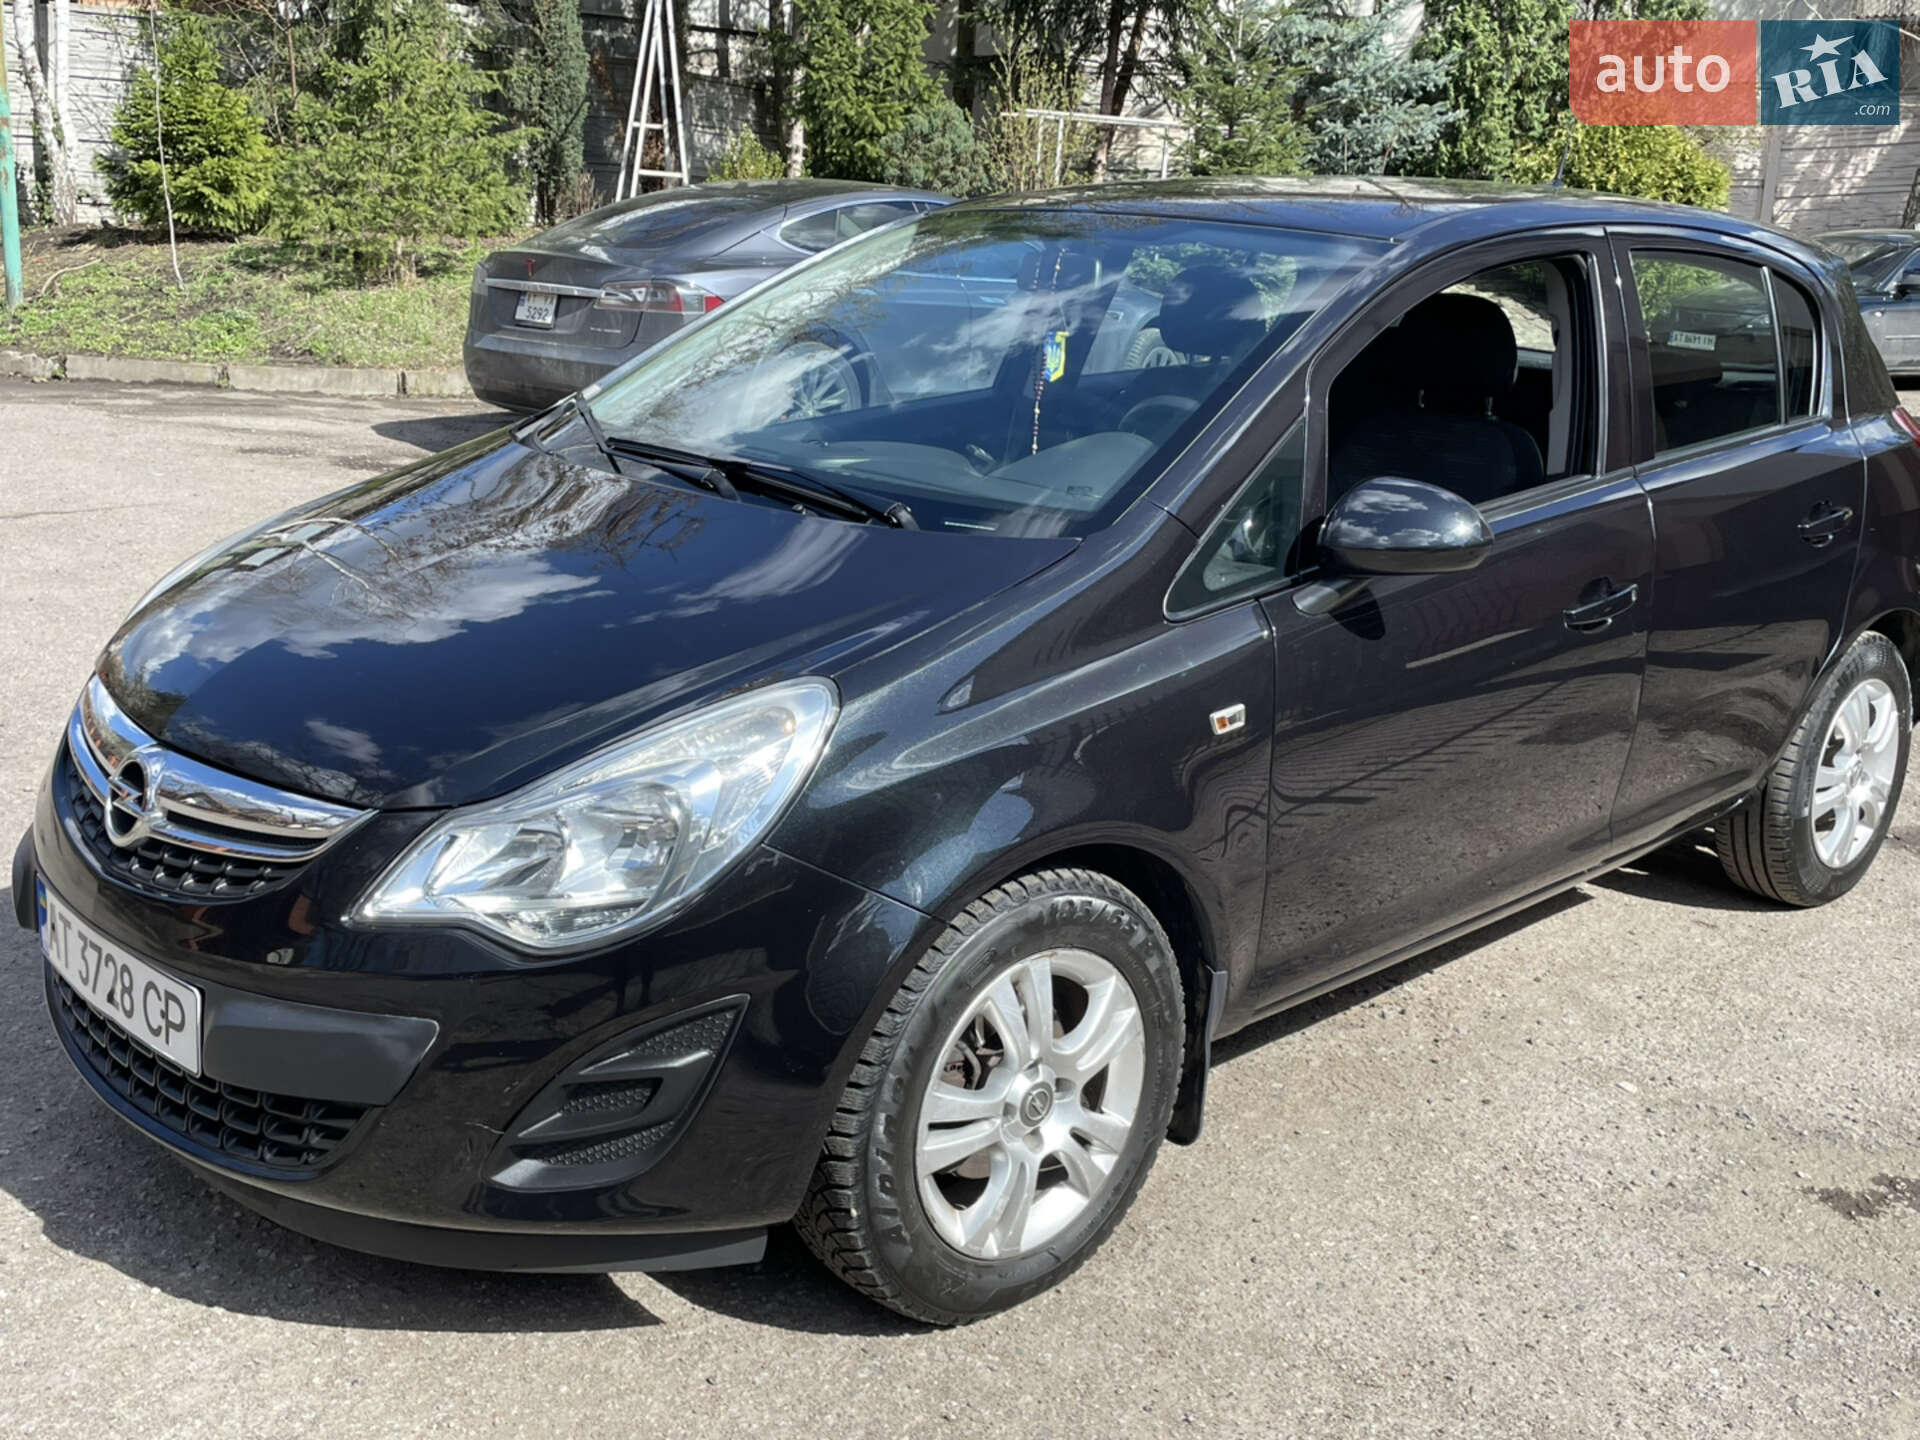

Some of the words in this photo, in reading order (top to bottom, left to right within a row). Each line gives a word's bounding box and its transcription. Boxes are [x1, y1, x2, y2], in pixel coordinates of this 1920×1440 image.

[526, 306, 550, 321] 5292
[77, 930, 135, 1020] 3728
[142, 980, 186, 1046] CP
